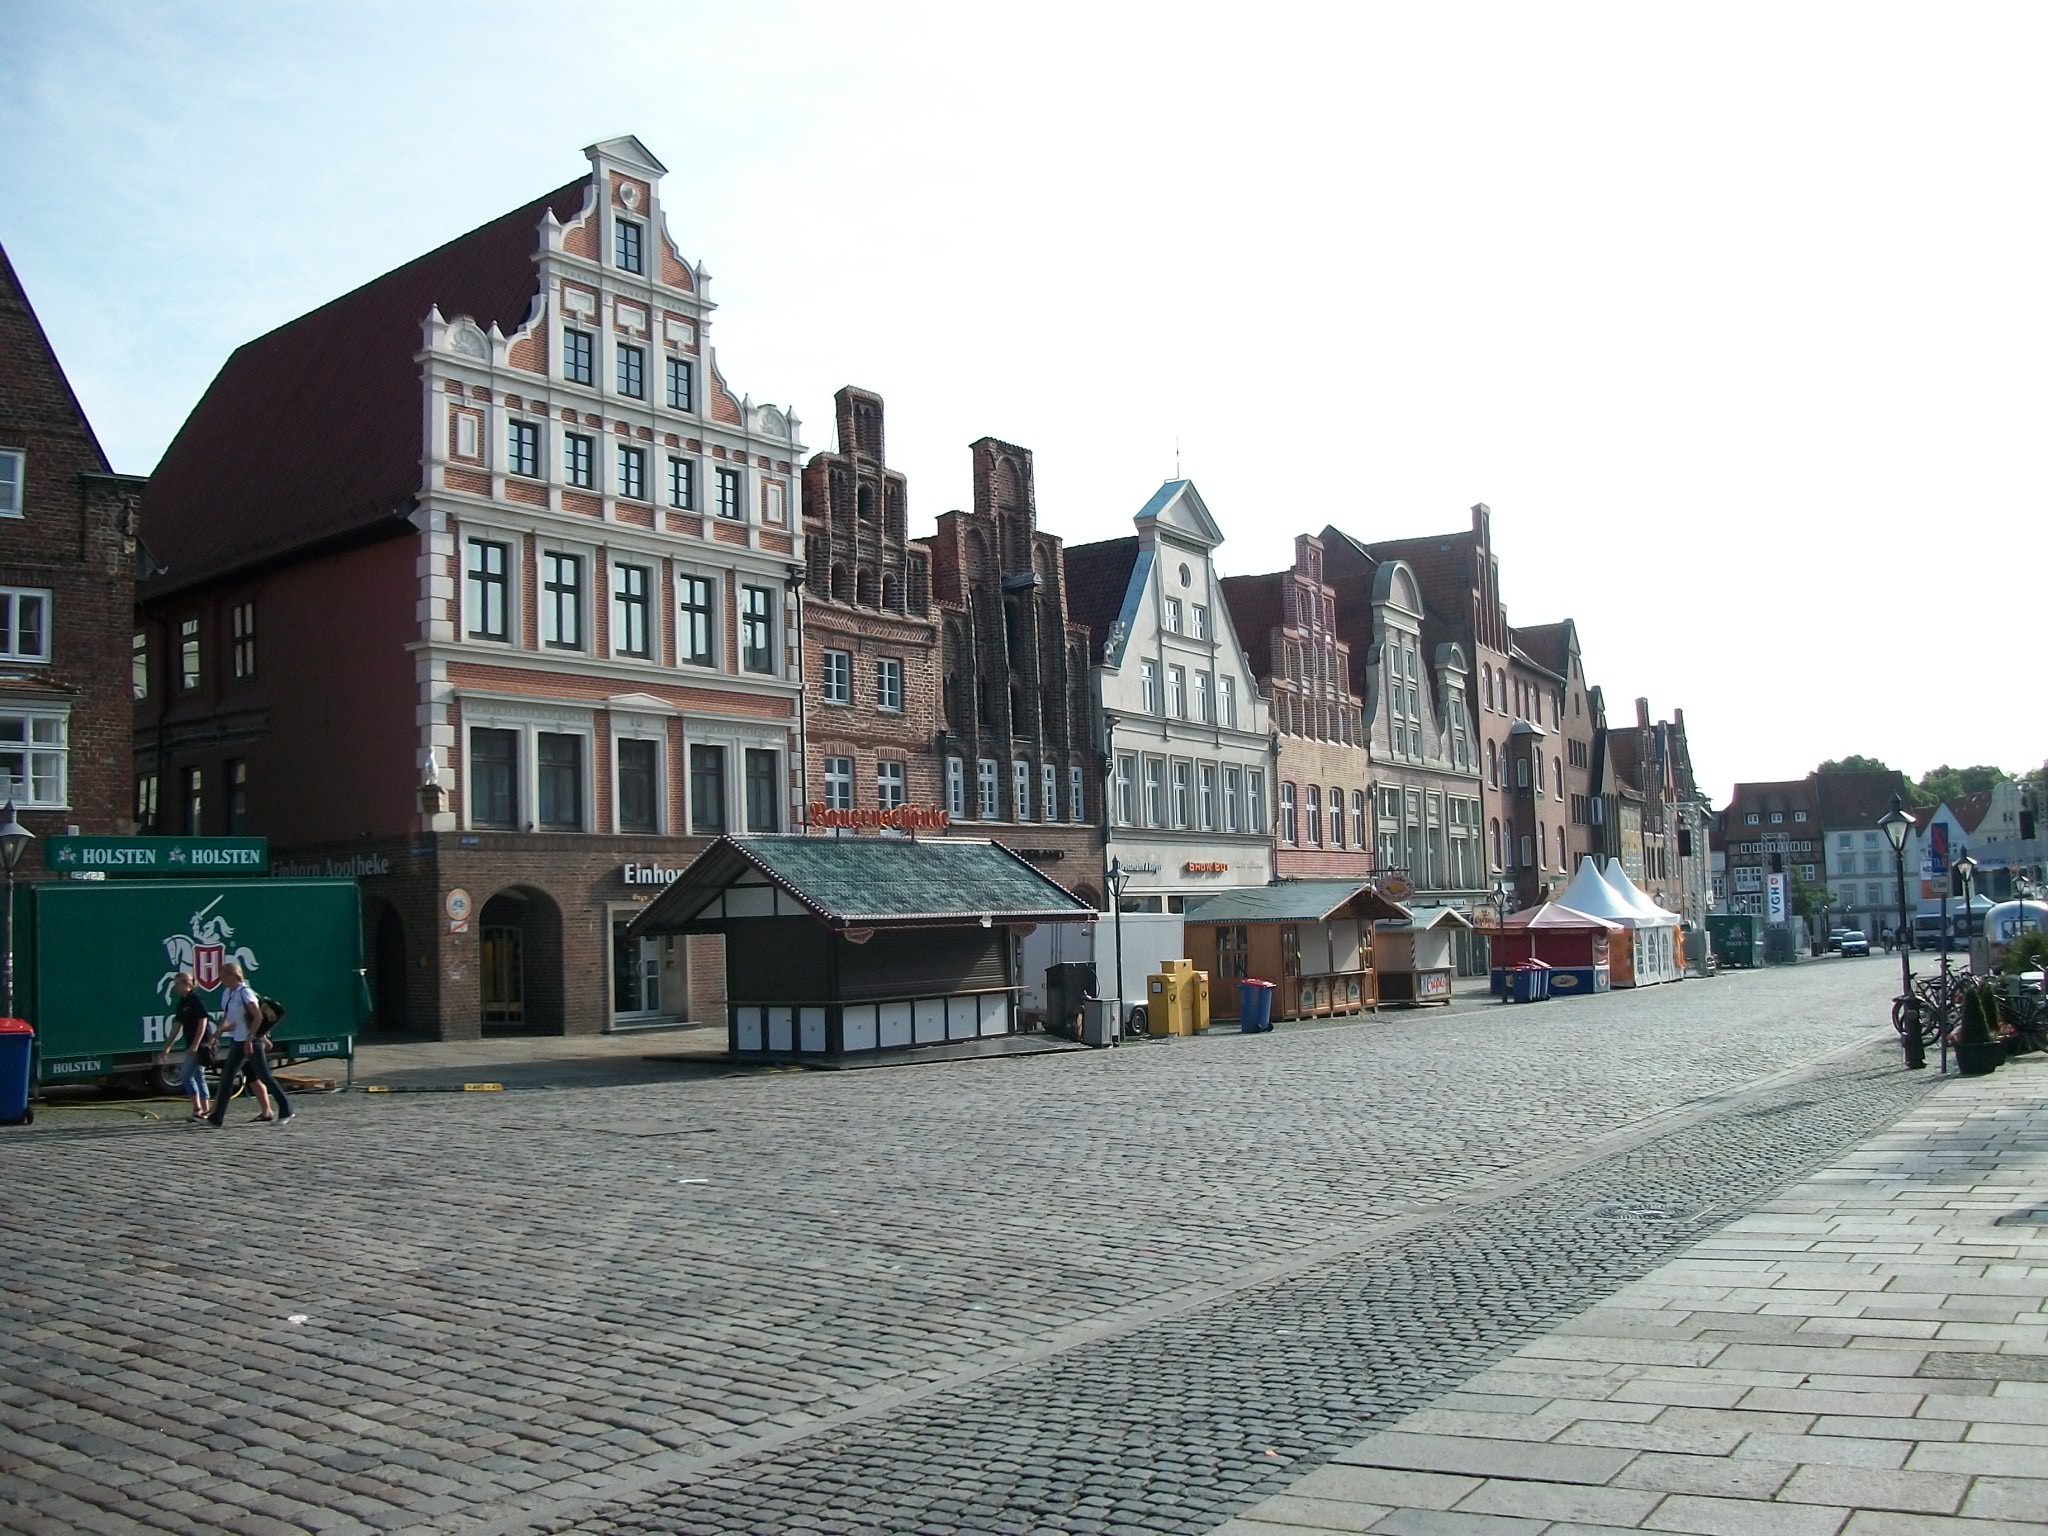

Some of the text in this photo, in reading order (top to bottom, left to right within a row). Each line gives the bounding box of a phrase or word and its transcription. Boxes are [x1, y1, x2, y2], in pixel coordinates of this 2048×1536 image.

[809, 801, 950, 829] Bauernschänke
[82, 849, 260, 864] HOLSTEN HOLSTEN
[624, 862, 687, 884] Einhor
[1771, 887, 1780, 914] VGH
[298, 1041, 339, 1053] HOLSTEN
[52, 1060, 101, 1073] HOLSTEN
